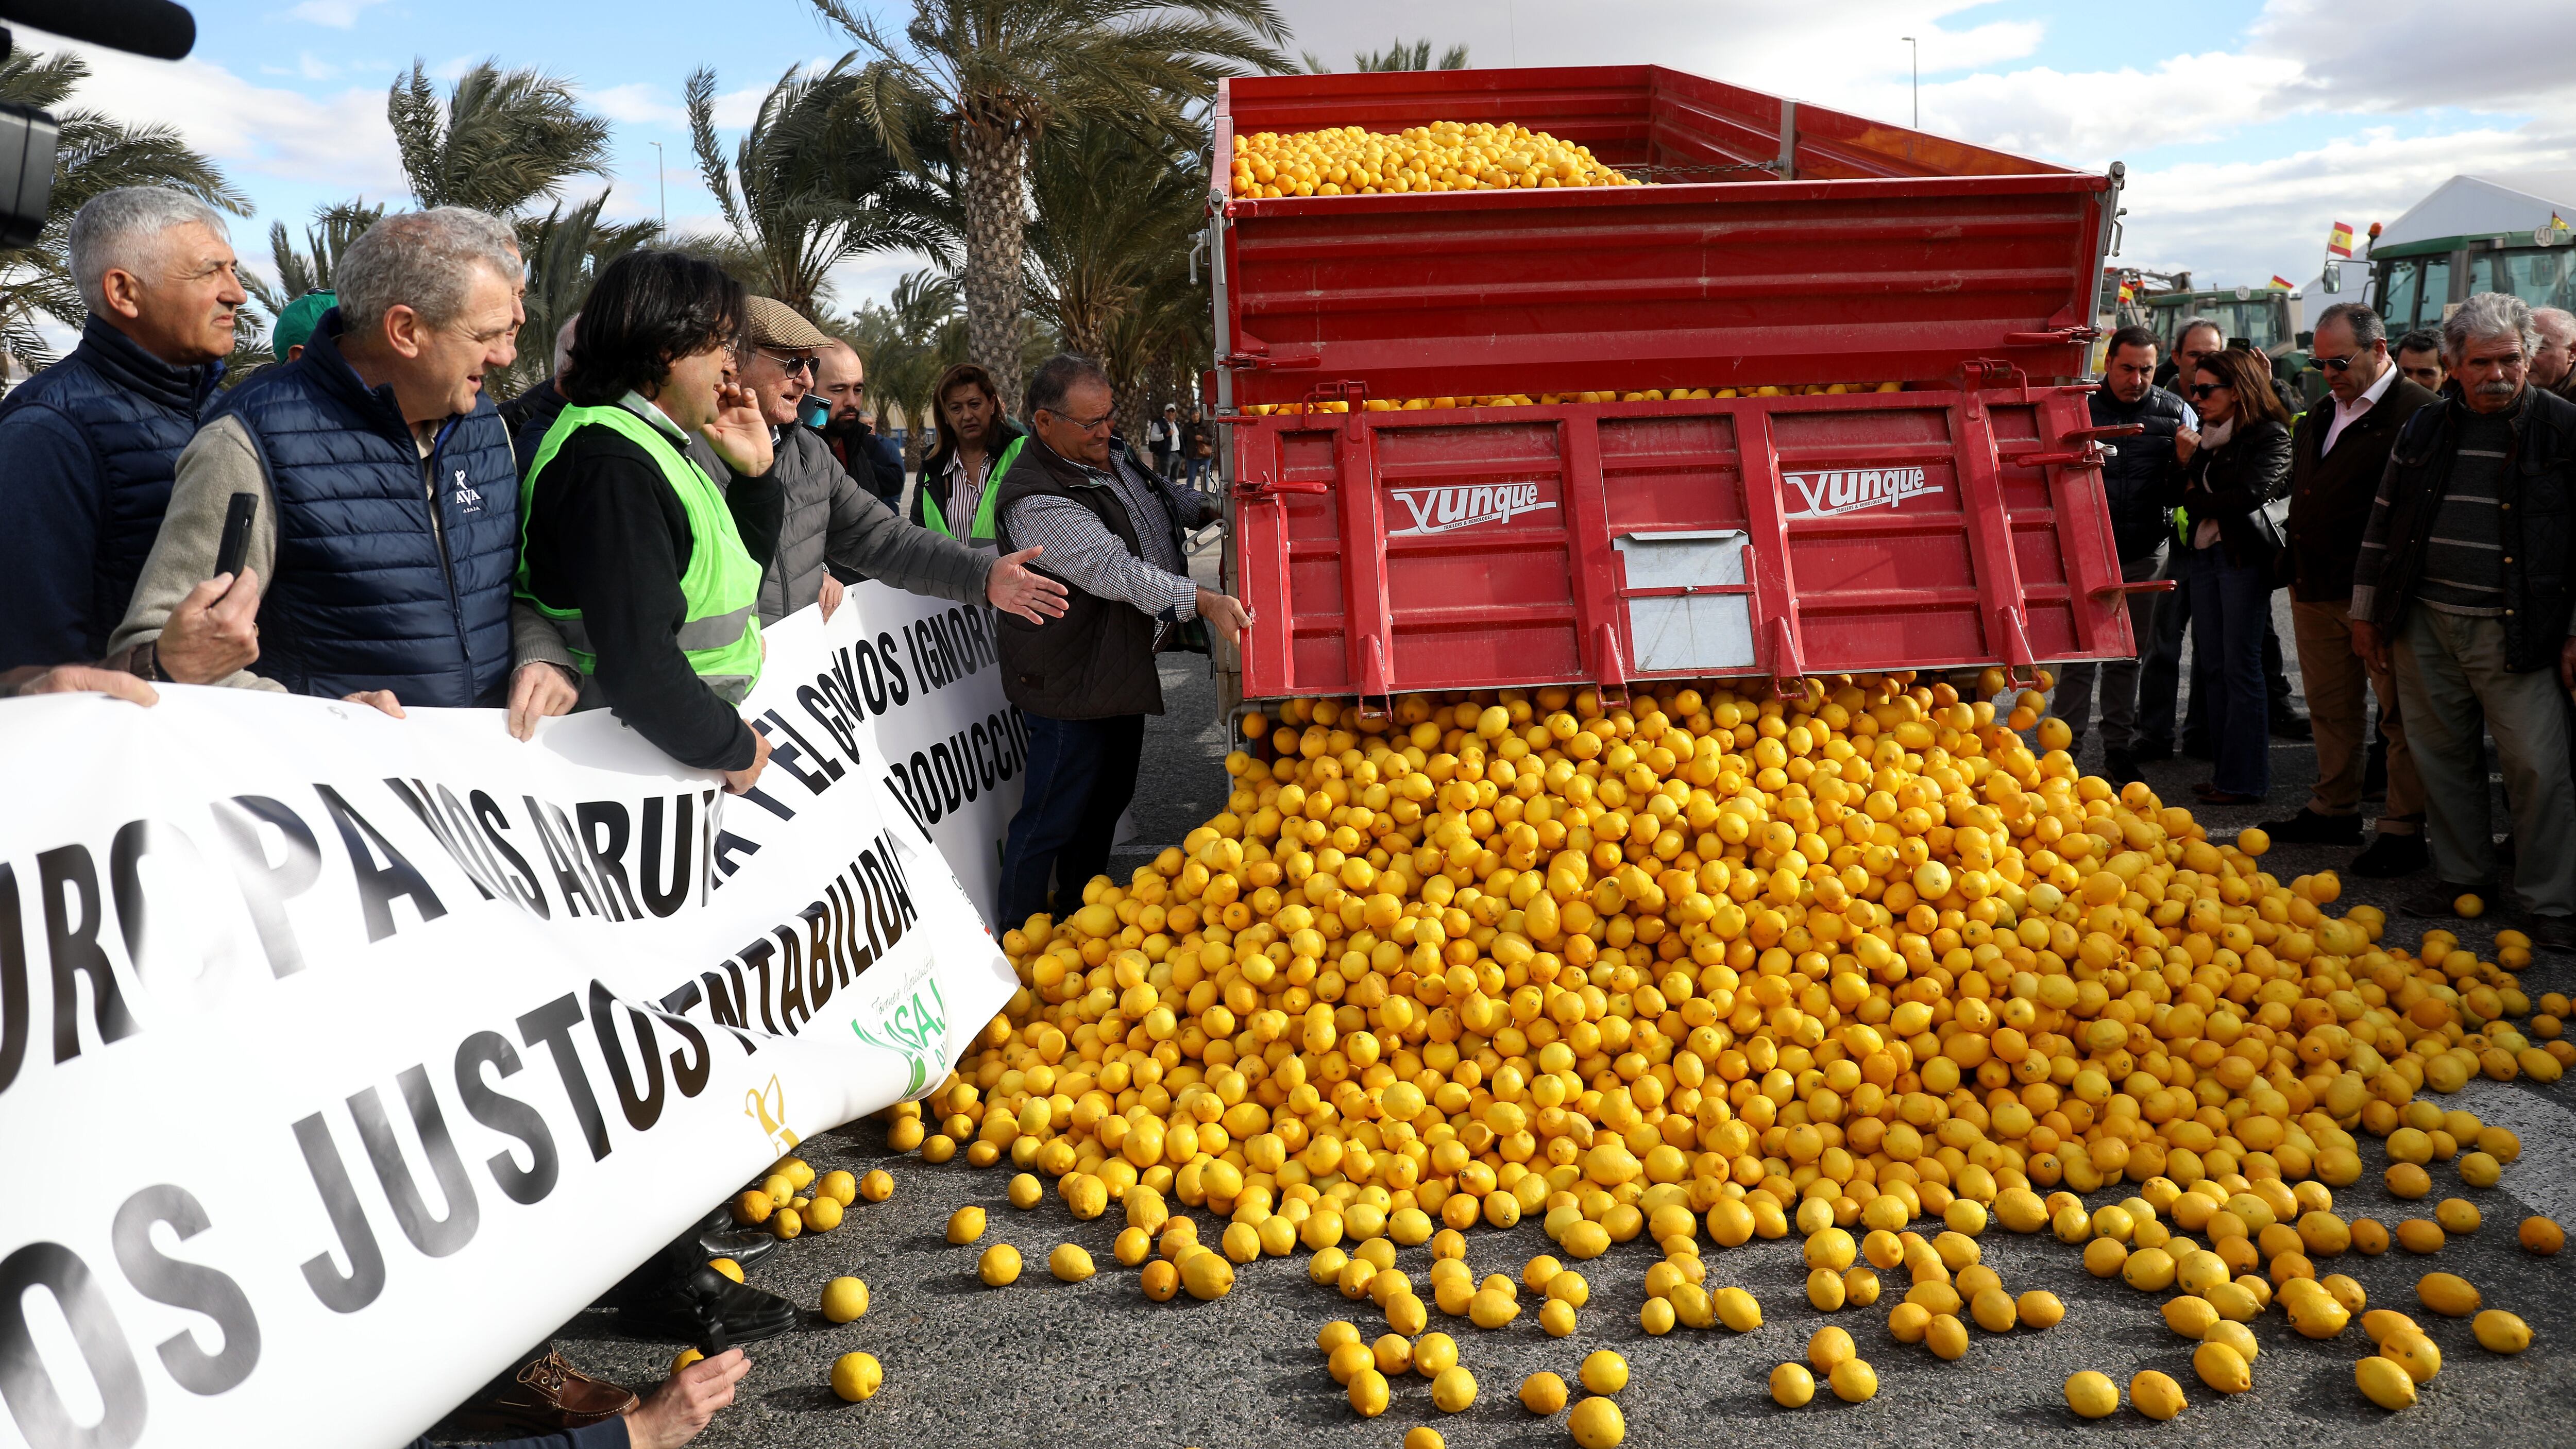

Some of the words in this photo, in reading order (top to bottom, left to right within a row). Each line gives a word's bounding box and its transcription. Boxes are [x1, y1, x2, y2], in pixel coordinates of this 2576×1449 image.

[2536, 228, 2551, 244] 40
[456, 489, 481, 505] AVA
[1785, 469, 1924, 517] Yunque
[1392, 484, 1538, 534] Yunque
[1859, 499, 1883, 507] REMOLQUES
[1444, 522, 1462, 530] TRAILERS
[1468, 515, 1493, 524] REMOLQUES
